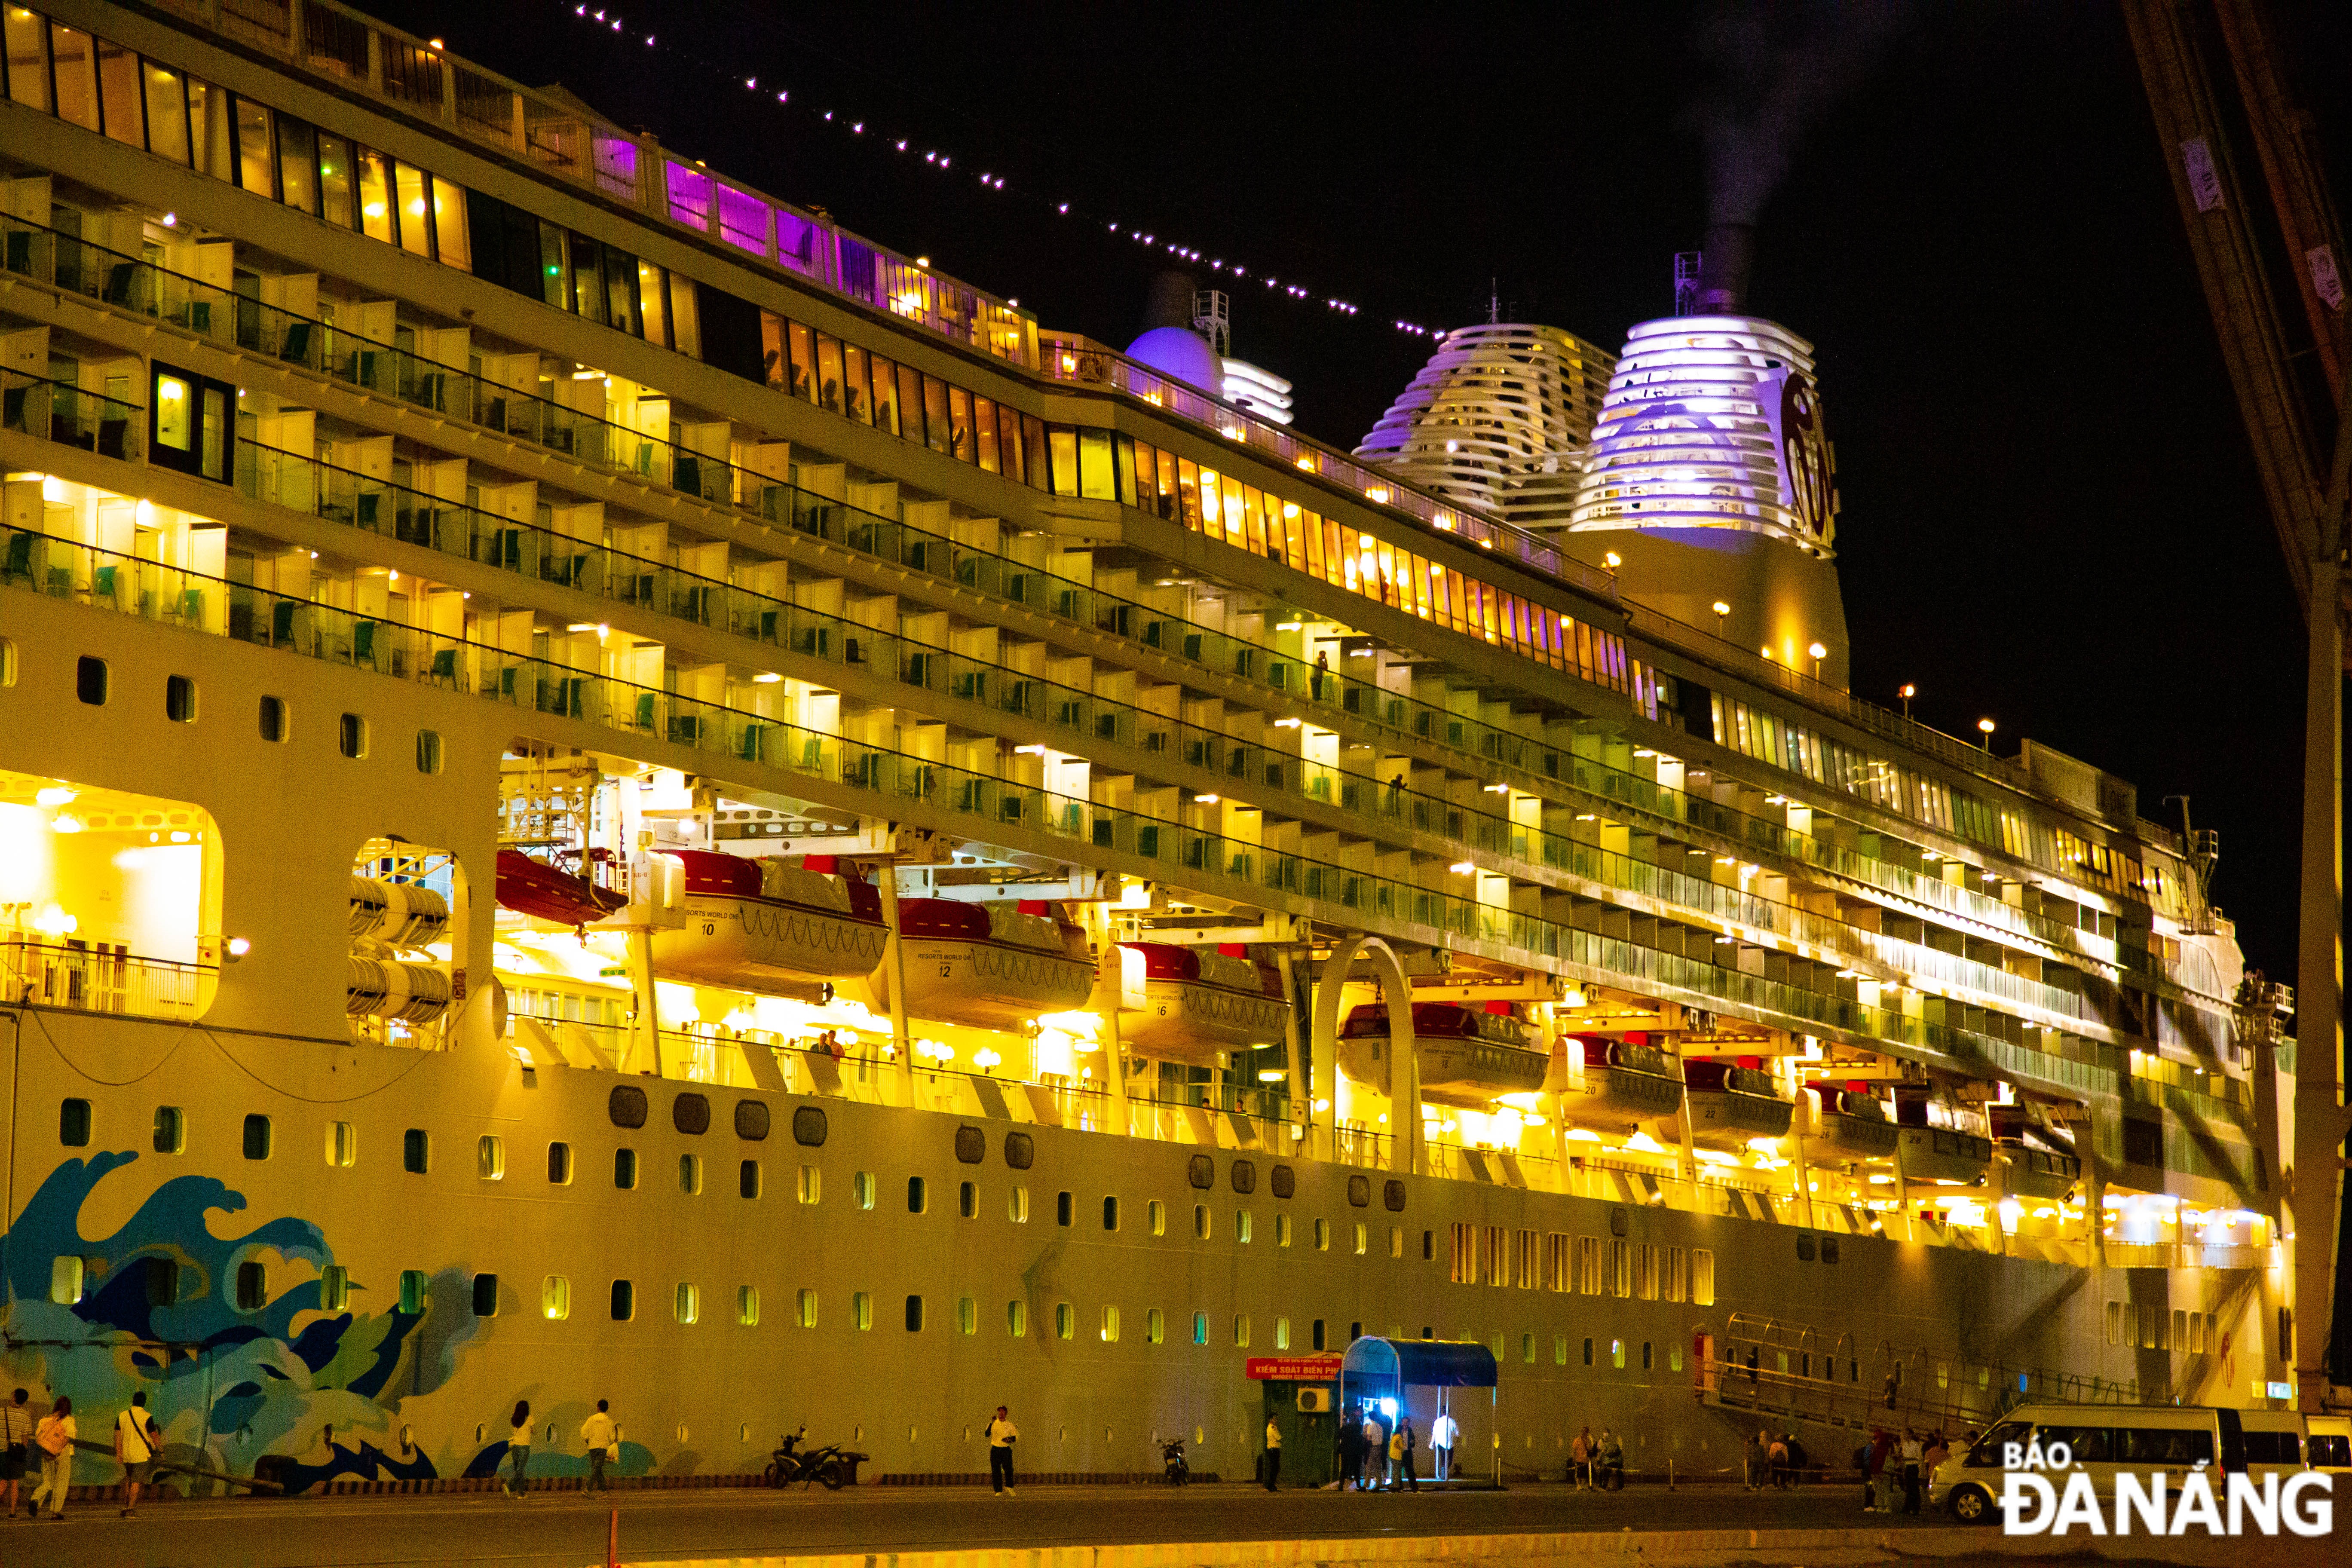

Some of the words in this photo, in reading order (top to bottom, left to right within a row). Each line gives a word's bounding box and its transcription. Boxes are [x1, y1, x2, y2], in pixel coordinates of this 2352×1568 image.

[686, 909, 705, 917] SORTS
[701, 923, 714, 936] 10
[940, 966, 950, 977] 12
[1157, 1005, 1167, 1016] 16
[1585, 1086, 1596, 1095] 20
[1705, 1110, 1715, 1118] 22
[1256, 1363, 1277, 1373] KIỂM
[1279, 1364, 1301, 1374] SOÁT
[1303, 1365, 1323, 1375] BIÊN
